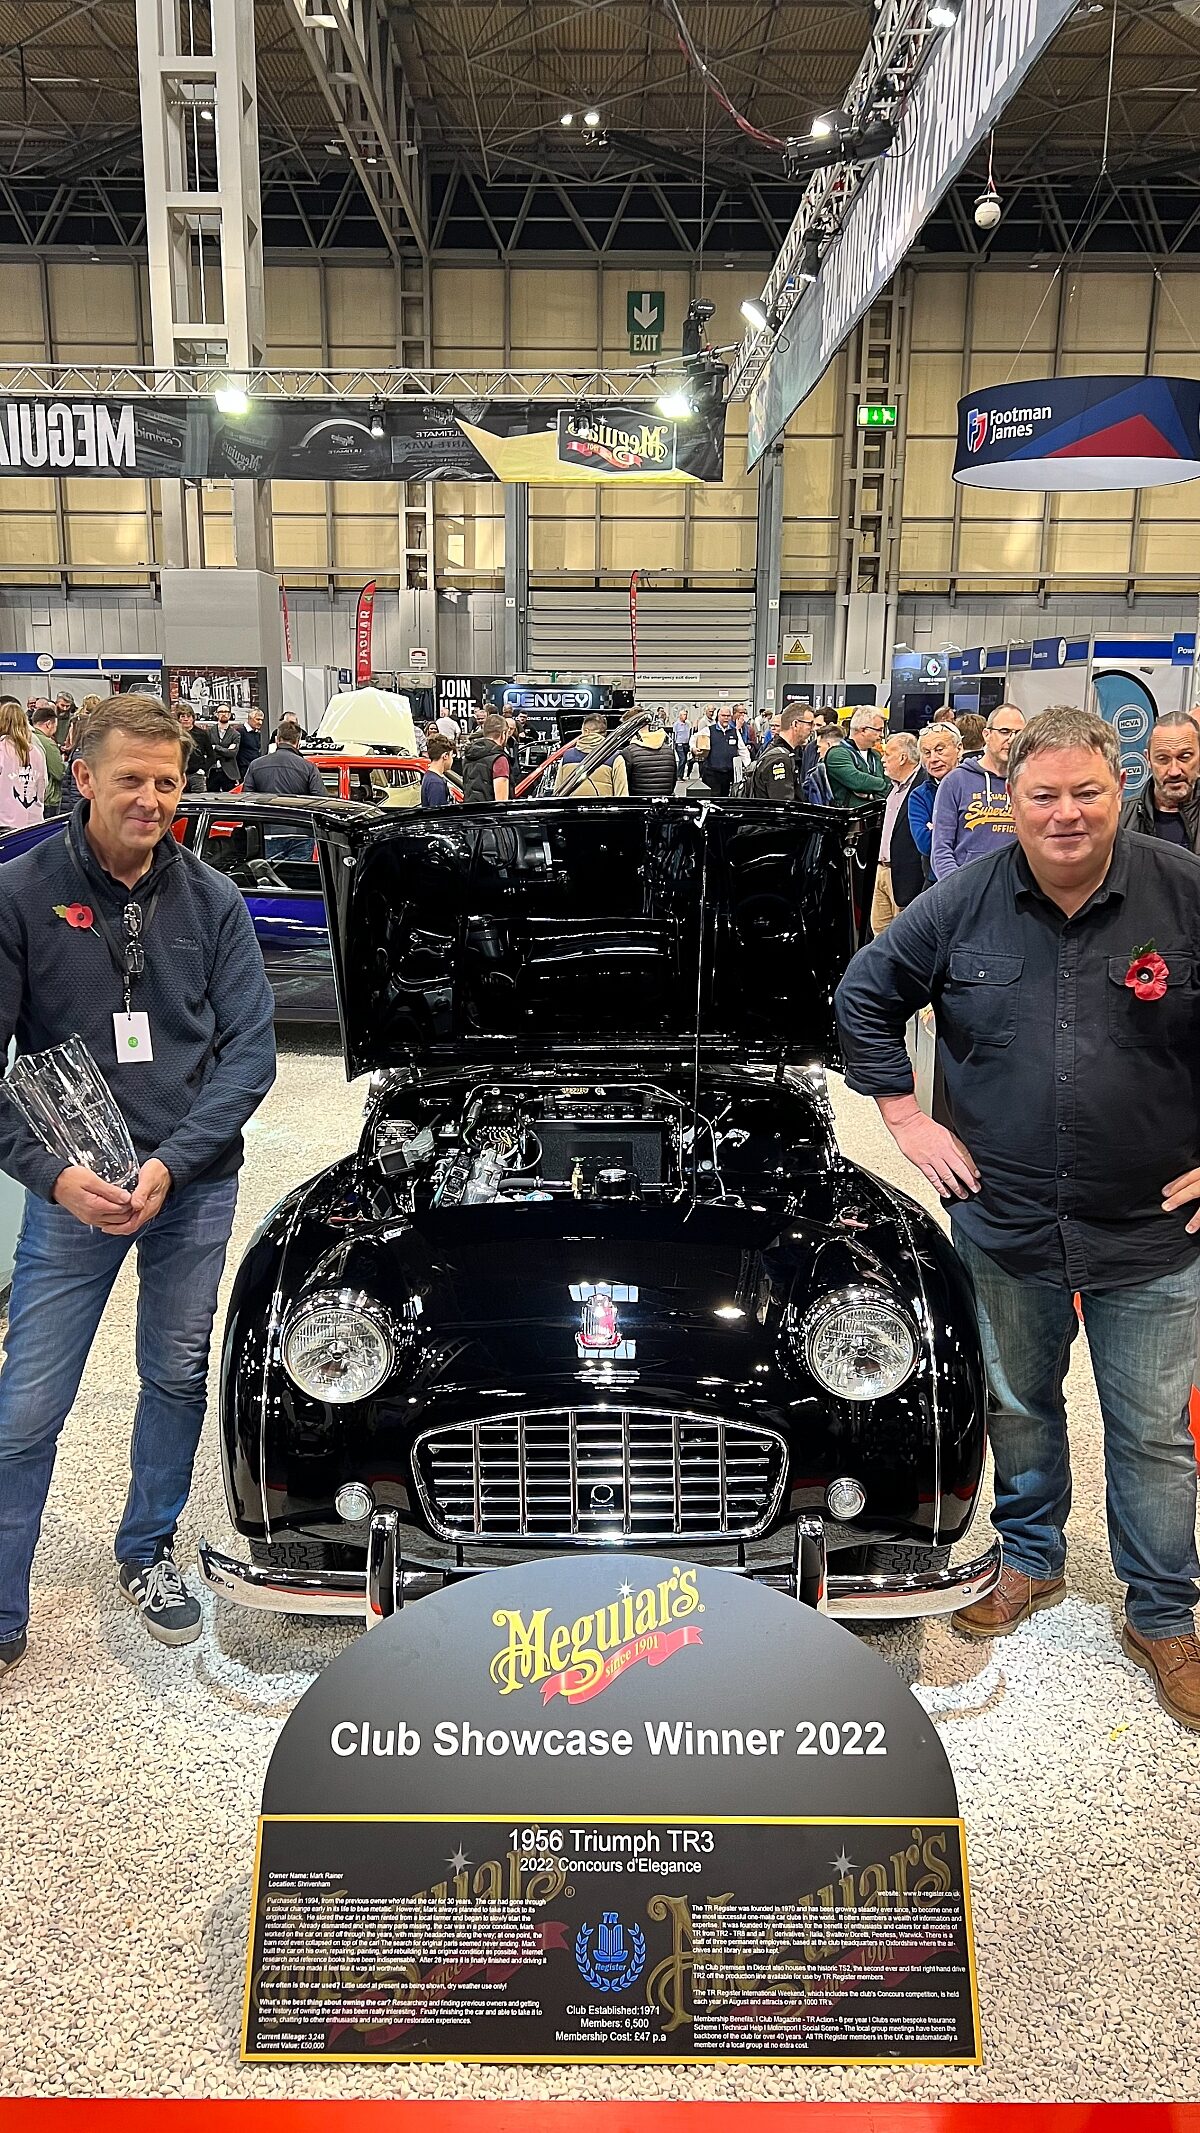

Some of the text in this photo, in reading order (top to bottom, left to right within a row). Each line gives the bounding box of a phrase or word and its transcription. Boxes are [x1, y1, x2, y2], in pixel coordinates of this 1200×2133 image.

[634, 334, 658, 352] EXIT
[990, 406, 1052, 426] Footman
[990, 424, 1033, 444] James
[360, 610, 370, 664] JAGUAR
[440, 680, 470, 698] JOIN
[440, 700, 476, 718] HERE
[507, 693, 590, 708] JENVEY
[488, 1566, 701, 1696] Meguiar's
[604, 1635, 660, 1679] since 1901
[330, 1720, 888, 1756] Club Showcase Winner 2022
[509, 1829, 715, 1856] 1956 Triumph TR3
[520, 1858, 702, 1876] 2022 Concours d'Elegance
[602, 1912, 619, 1924] TR
[594, 1963, 626, 1972] Register
[566, 2006, 660, 2016] Club Established:1971
[580, 2019, 649, 2029] Members: 6,500
[556, 2032, 666, 2044] Membership Cost: £47 p.a
